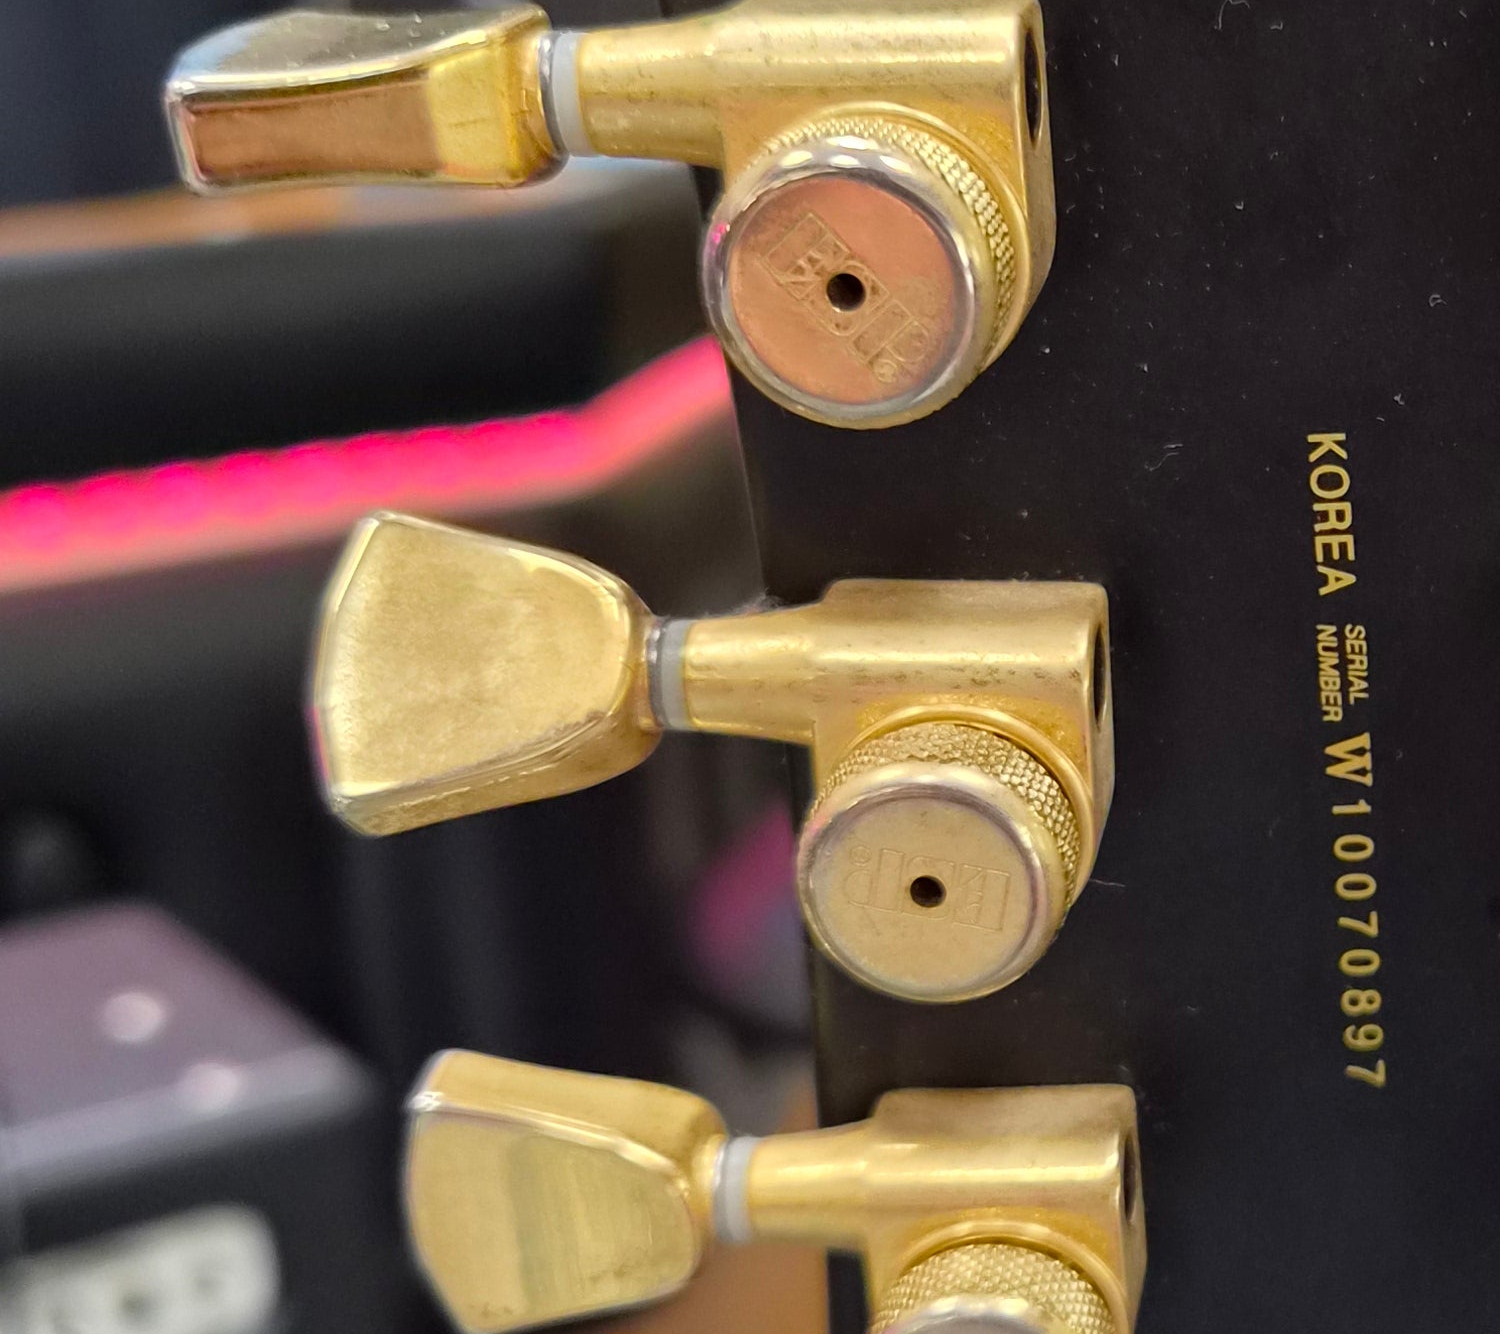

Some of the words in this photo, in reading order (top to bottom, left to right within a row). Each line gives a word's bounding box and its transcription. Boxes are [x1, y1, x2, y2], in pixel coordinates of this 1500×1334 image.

[1307, 433, 1357, 596] KOREA
[1316, 624, 1343, 722] NUMBER
[1344, 623, 1370, 705] SERIAL
[1324, 732, 1387, 1089] W10070897
